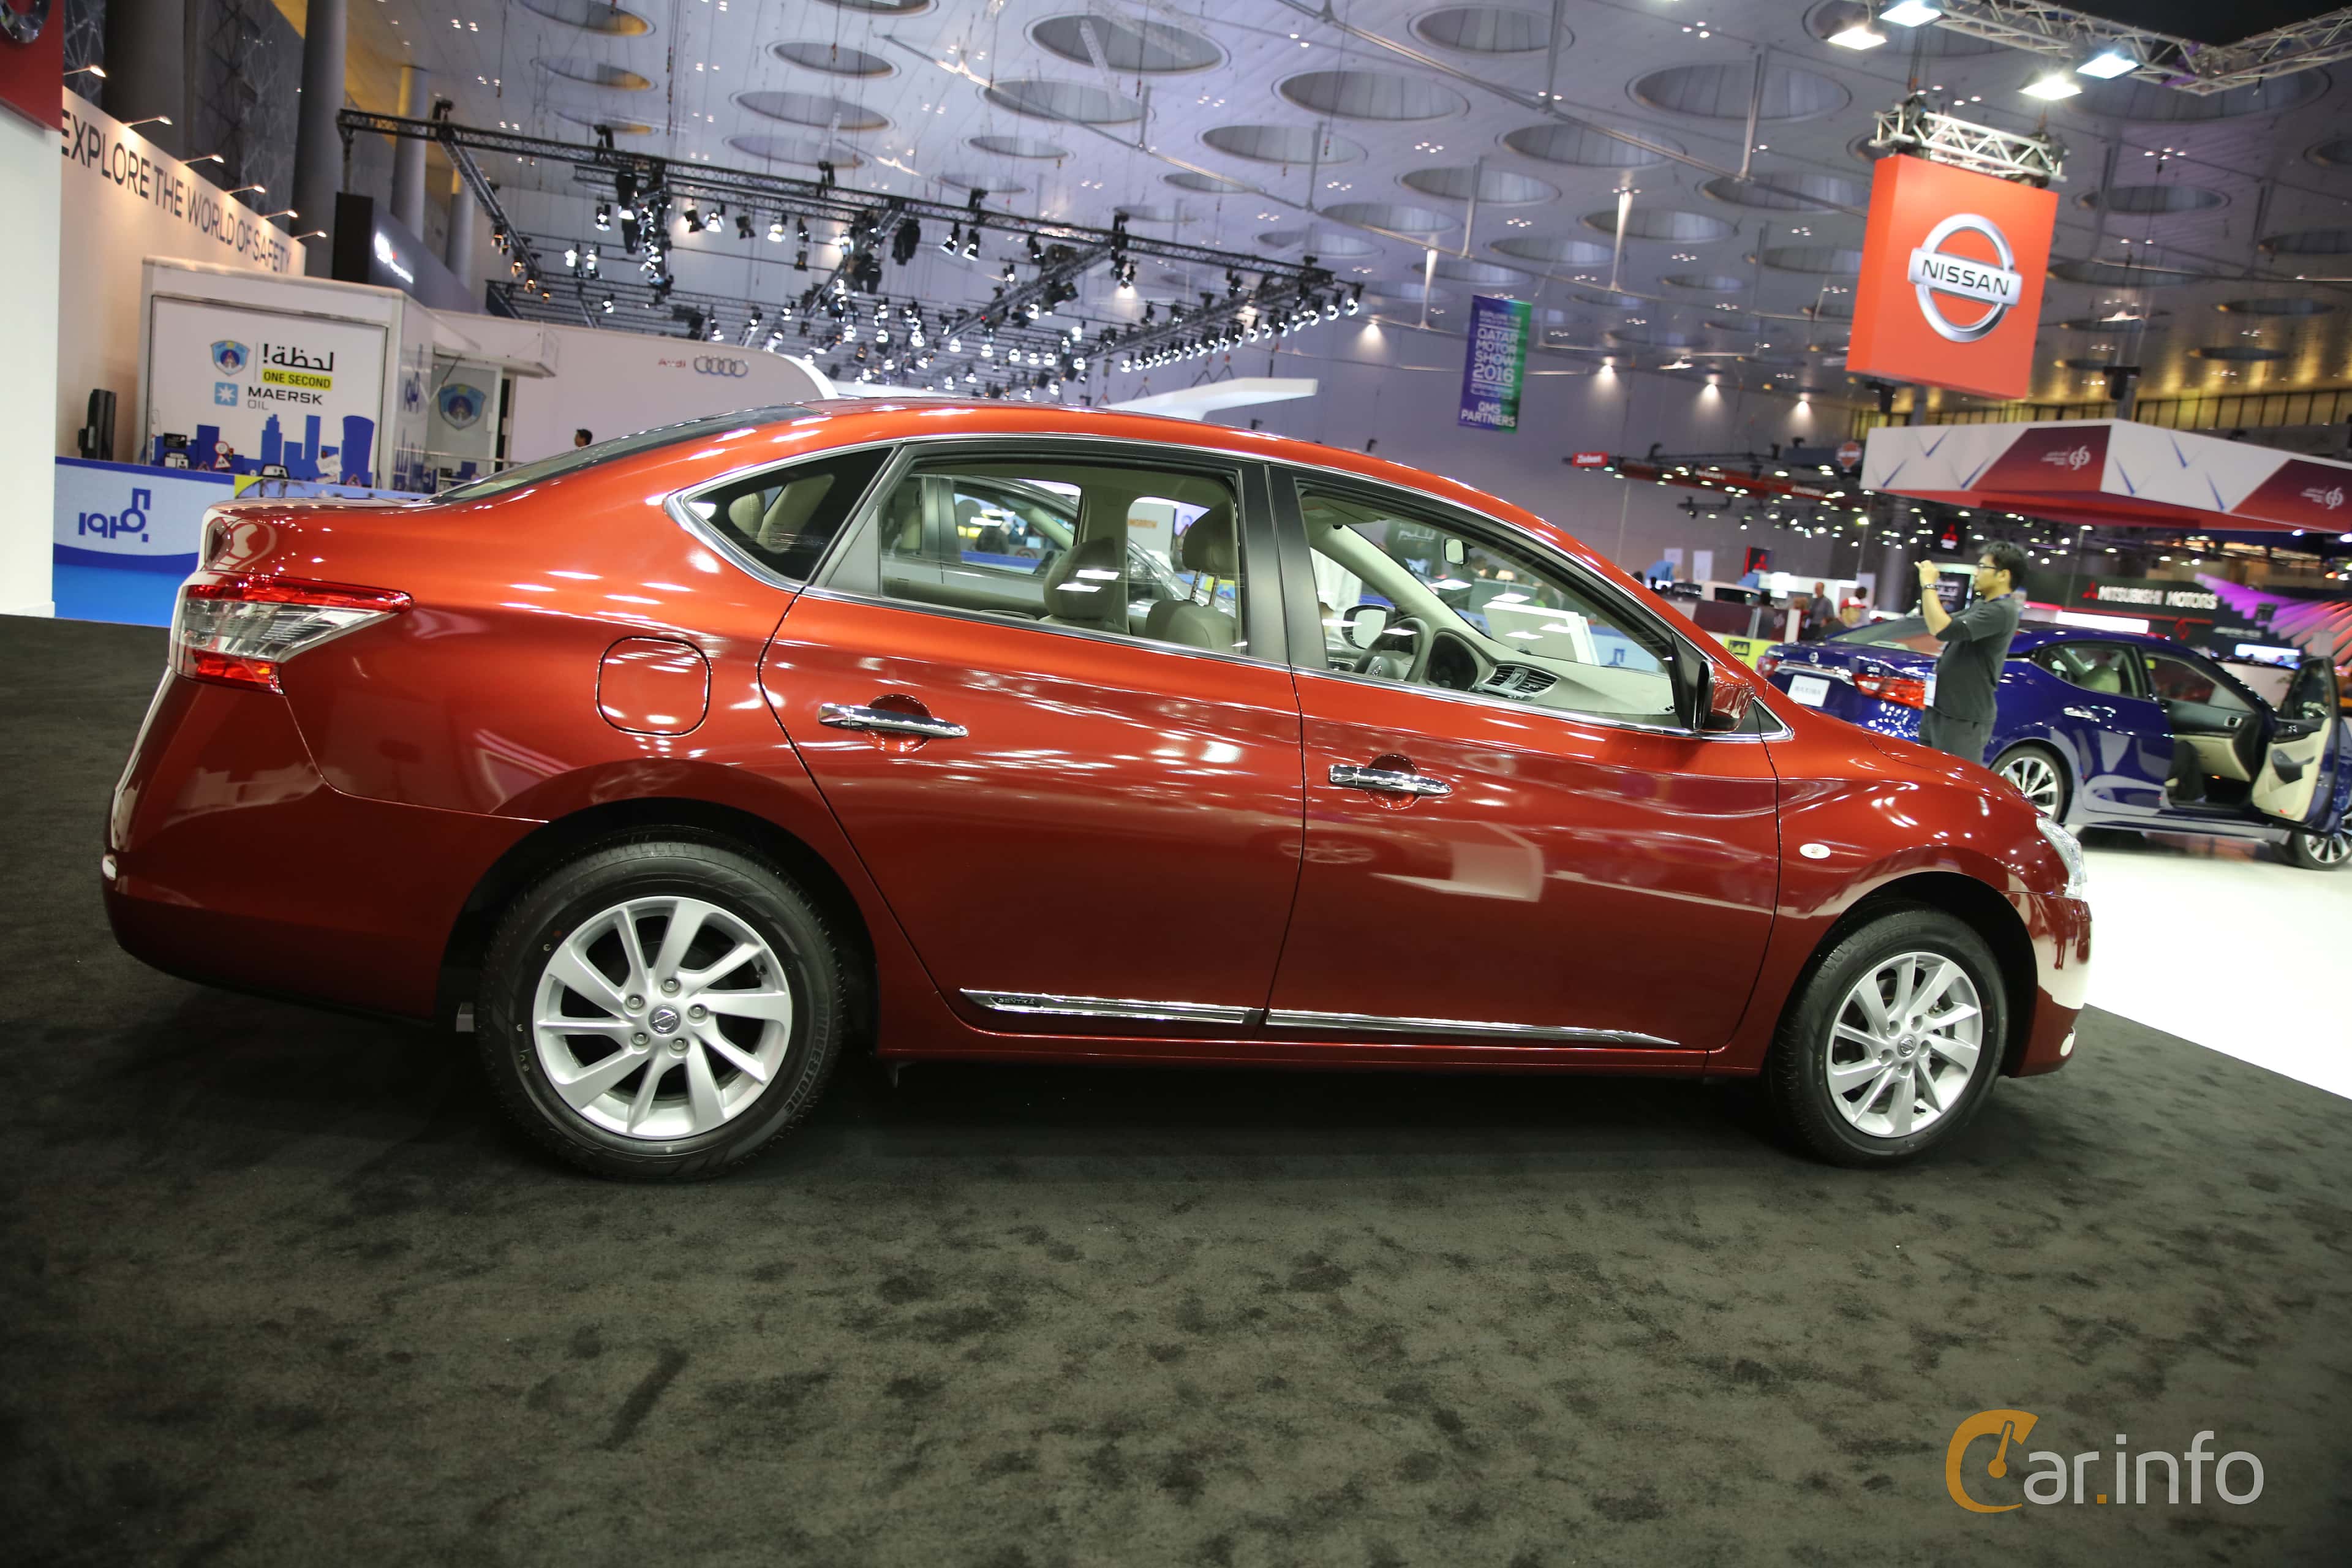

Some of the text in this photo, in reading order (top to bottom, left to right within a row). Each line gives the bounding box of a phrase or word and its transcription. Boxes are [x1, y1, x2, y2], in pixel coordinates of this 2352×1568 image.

[62, 108, 291, 273] EXPLORE THE WORLD OF SAFETY
[1922, 259, 2010, 296] NISSAN
[1477, 328, 1519, 344] QATAR
[1476, 339, 1518, 355] MOTOR
[262, 343, 334, 372] لحظة!
[1474, 350, 1517, 366] SHOW
[264, 371, 331, 389] ONE SECOND
[1472, 363, 1515, 383] 2016
[247, 386, 323, 405] MAERSK
[247, 399, 268, 410] OIL
[1478, 401, 1501, 414] QMS
[1461, 409, 1516, 428] PARTNERS
[2097, 586, 2218, 610] MITSUBISHI MOTORS
